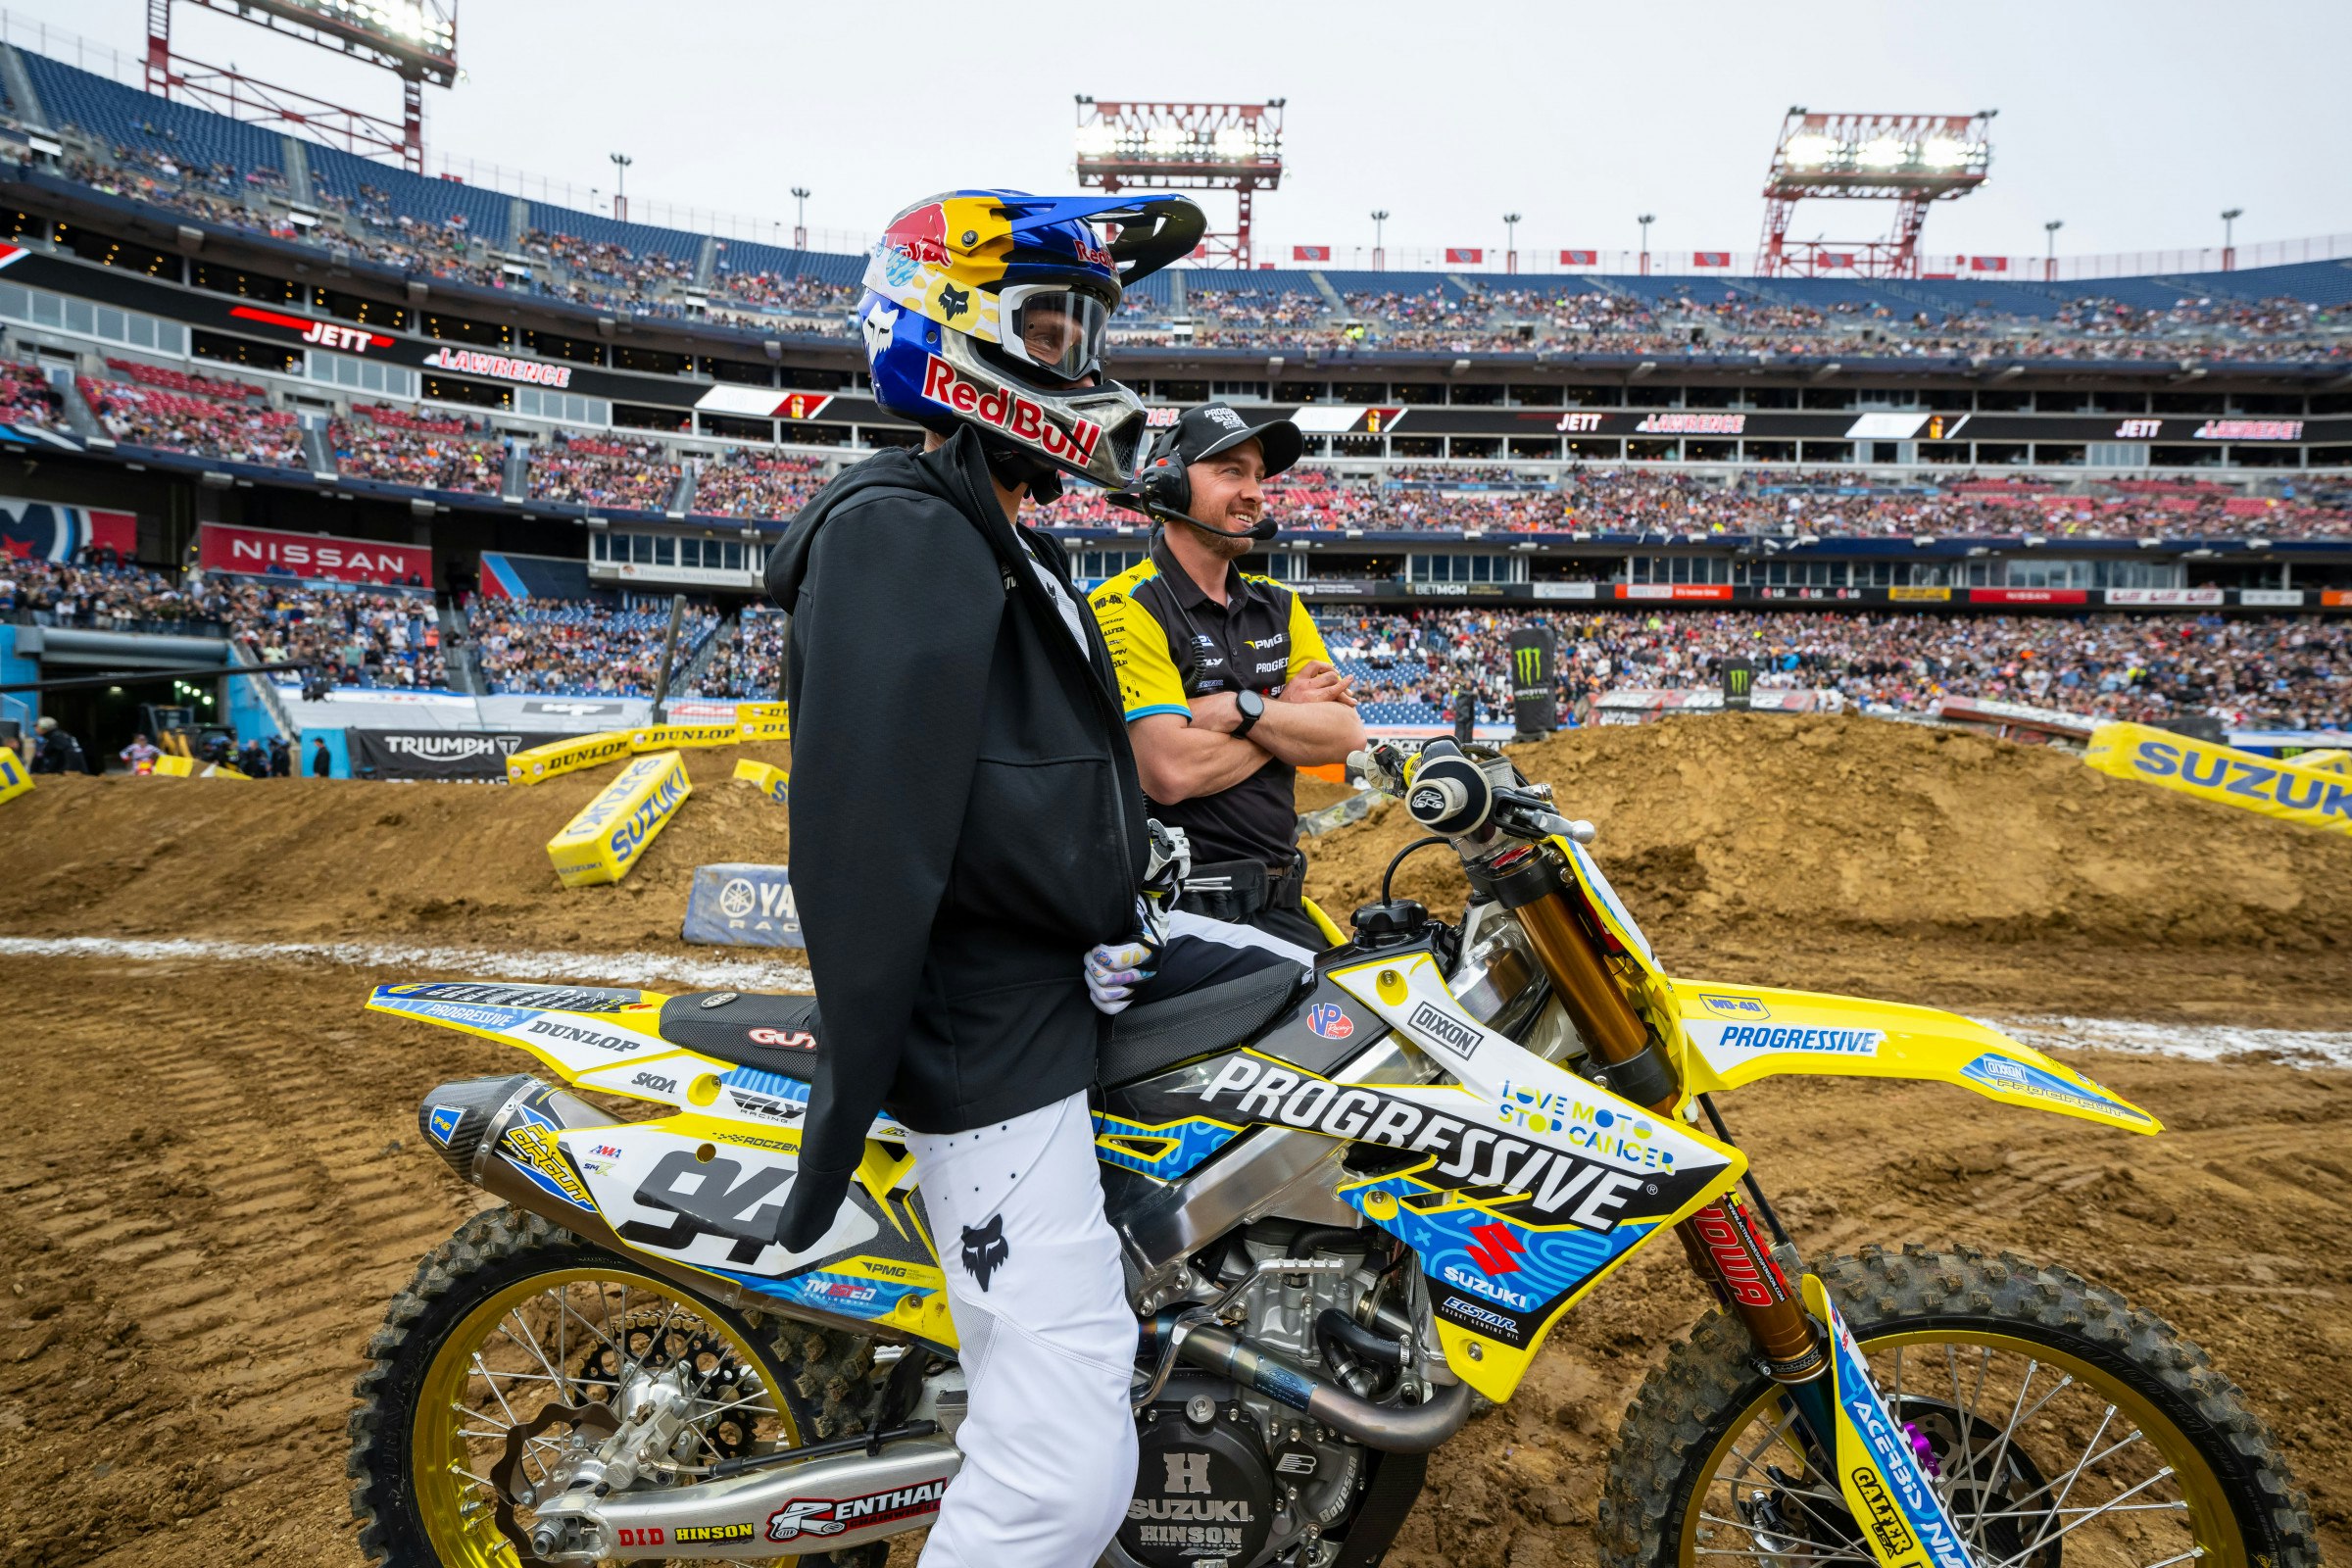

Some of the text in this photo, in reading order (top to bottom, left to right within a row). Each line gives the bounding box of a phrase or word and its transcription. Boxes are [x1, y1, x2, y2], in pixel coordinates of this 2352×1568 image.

[302, 320, 571, 389] JETT LAWRENCE
[1556, 413, 1746, 433] JETT LAWRENCE
[2115, 419, 2162, 438] JETT
[232, 538, 405, 573] NISSAN
[1415, 585, 1467, 596] BETMGM
[1102, 626, 1125, 637] ALFER
[1254, 633, 1283, 650] PMG
[1256, 658, 1290, 673] PROGRES
[384, 736, 495, 757] TRIUMPH
[652, 728, 735, 743] DUNLOP
[550, 741, 629, 769] DUNLOP
[2134, 742, 2352, 819] SUZUK
[612, 766, 686, 863] SUZUKI
[558, 861, 603, 876] SUZUKI
[728, 919, 799, 933] RAC
[424, 1004, 514, 1027] PROGRESSIVE
[1708, 997, 1761, 1013] WD-40
[1311, 1003, 1342, 1037] VP
[1416, 1007, 1475, 1054] DIXXON
[527, 1020, 640, 1053] DUNLOP
[748, 1029, 817, 1050] GUT
[1720, 1026, 1878, 1054] PROGRESSIVE
[631, 1072, 678, 1094] SKDA
[729, 1091, 807, 1119] FLY
[1502, 1080, 1653, 1140] LOVE MOTO
[1996, 1078, 2125, 1117] PRO CIRCUIT
[588, 1145, 622, 1158] AMA
[1200, 1055, 1645, 1237] PROGRESSIVE
[1498, 1103, 1676, 1175] STOP CANCER
[509, 1129, 592, 1203] CIRCUIT
[616, 1150, 800, 1266] 94
[1727, 1201, 1786, 1302] WWW.ACTIVERIDESUSPENSION.COM
[871, 1263, 906, 1278] PMG
[1444, 1266, 1527, 1308] SUZUKI
[1441, 1305, 1519, 1341] SUZUKI GENUINE OIL
[1443, 1296, 1520, 1334] ECSTAR
[1126, 1498, 1250, 1522] SUZUKI
[1854, 1469, 1912, 1555] GALFER
[676, 1523, 754, 1542] HINSON
[1140, 1526, 1242, 1544] HINSON
[1870, 1523, 1895, 1559] USA
